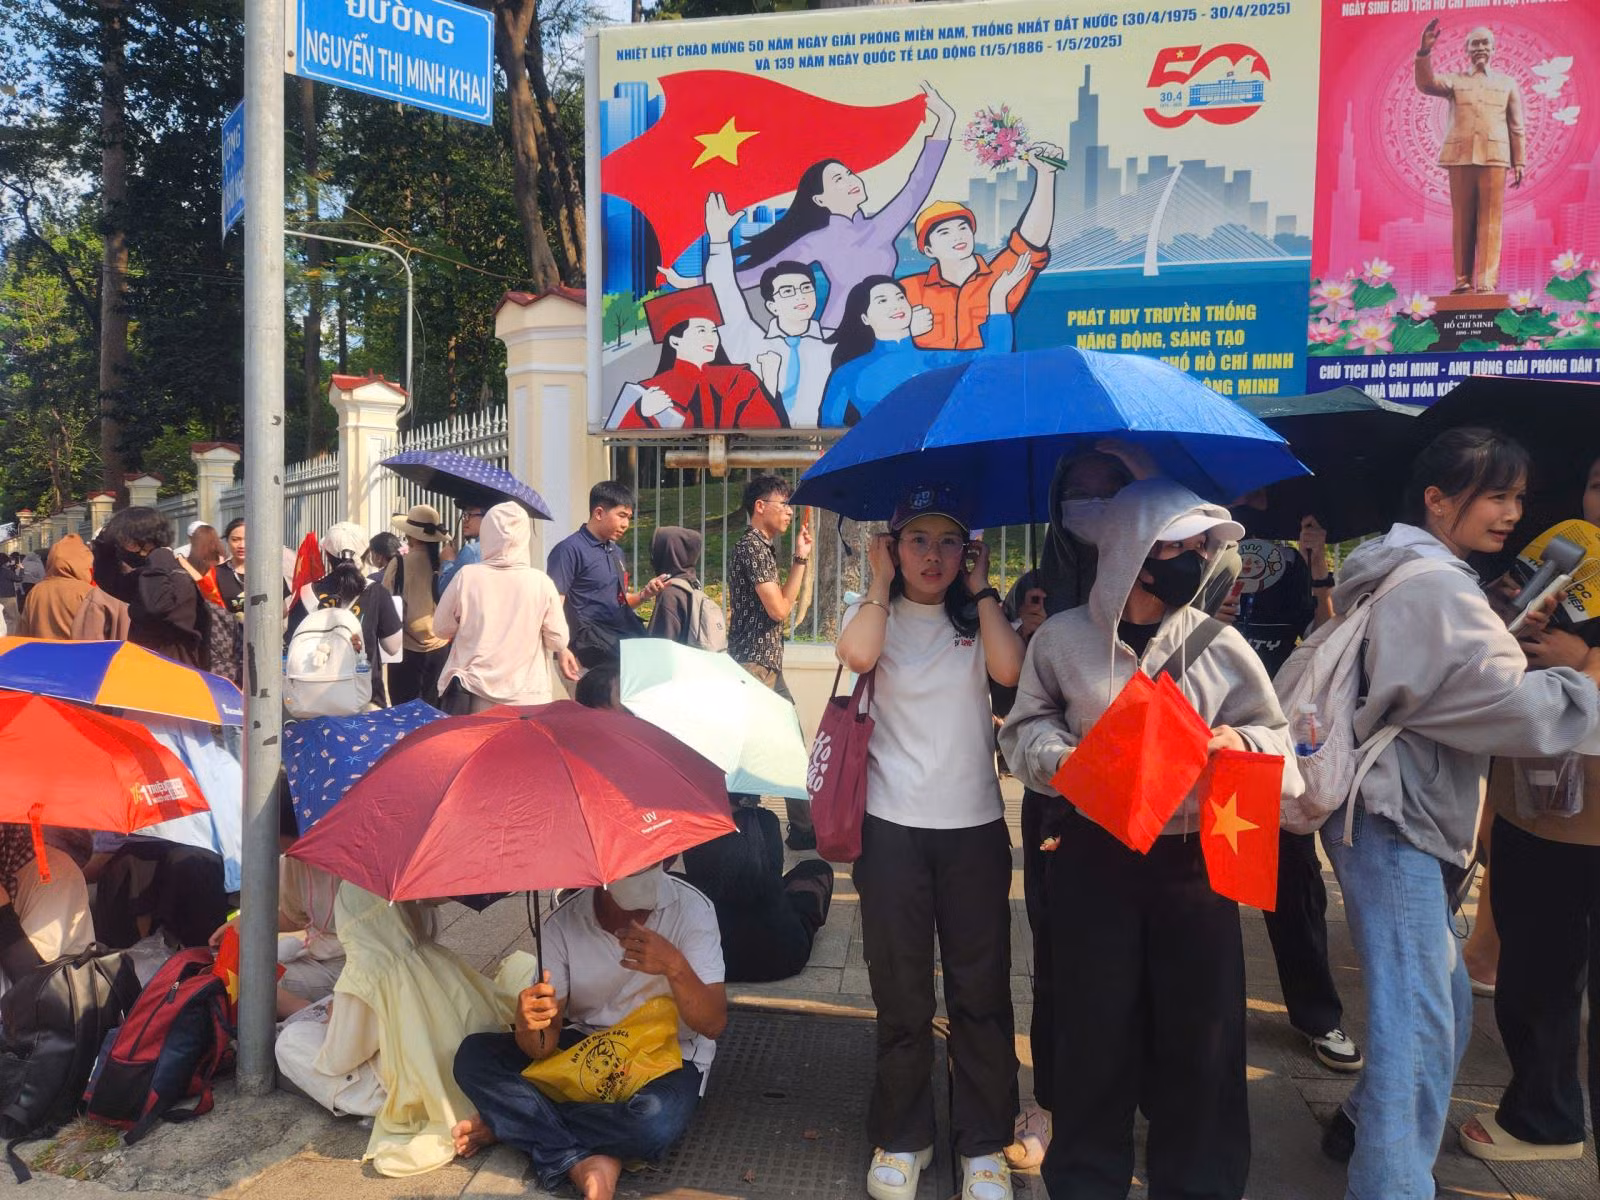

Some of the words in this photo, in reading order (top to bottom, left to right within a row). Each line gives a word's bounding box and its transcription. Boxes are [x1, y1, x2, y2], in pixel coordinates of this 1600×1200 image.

[1368, 1, 1389, 15] SINH
[1411, 0, 1431, 14] TỊCH
[347, 0, 455, 45] ĐƯỜNG
[616, 47, 648, 62] NHIỆT
[651, 46, 673, 61] LIỆT
[676, 43, 707, 57] CHÀO
[711, 40, 744, 54] MỪNG
[749, 40, 763, 51] 50
[768, 37, 793, 51] NĂM
[797, 34, 828, 49] NGÀY
[832, 32, 856, 46] GIẢI
[860, 29, 900, 45] PHÓNG
[904, 25, 934, 42] MIỀN
[938, 27, 968, 40] NAM,
[972, 20, 1013, 37] THỐNG
[1017, 17, 1050, 34] NHẤT
[1055, 15, 1079, 31] ĐẤT
[1083, 13, 1118, 29] NƯỚC
[1122, 8, 1197, 26] (30/4/1975
[1210, 1, 1291, 20] 30/4/2025)
[755, 57, 770, 71] VÀ
[775, 56, 795, 70] 139
[799, 53, 824, 68] NĂM
[829, 51, 859, 66] NGÀY
[863, 47, 896, 65] QUỐC
[900, 45, 913, 62] TẾ
[917, 47, 938, 61] LAO
[943, 43, 976, 61] ĐỘNG
[980, 40, 1043, 57] (1/5/1886
[1056, 34, 1122, 51] 1/5/2025)
[306, 28, 374, 78] NGUYỄN
[378, 48, 403, 91] THỊ
[406, 56, 446, 97] MINH
[450, 68, 486, 107] KHAI
[1067, 308, 1105, 326] PHÁT
[1110, 308, 1140, 325] HUY
[1144, 301, 1201, 324] TRUYỀN
[1205, 300, 1257, 322] THỐNG
[1457, 320, 1471, 328] CHÍ
[1077, 332, 1116, 350] NĂNG
[1121, 330, 1166, 351] ĐỘNG,
[1170, 329, 1211, 347] SÁNG
[1216, 330, 1245, 349] TẠO
[1195, 350, 1216, 371] HỒ
[1220, 352, 1248, 370] CHÍ
[1252, 353, 1294, 370] MINH
[1319, 362, 1341, 379] CHỦ
[1343, 364, 1369, 381] TỊCH
[1371, 360, 1386, 378] HỒ
[1388, 361, 1408, 377] CHÍ
[1410, 362, 1439, 376] MINH
[1448, 361, 1471, 376] ANH
[1473, 358, 1503, 375] HÙNG
[1505, 356, 1528, 374] GIẢI
[1531, 357, 1568, 374] PHÓNG
[1570, 356, 1593, 373] DÂN
[1238, 378, 1279, 395] MINH
[1364, 382, 1386, 398] NHÀ
[1388, 381, 1410, 398] VĂN
[1412, 381, 1434, 397] HÓA
